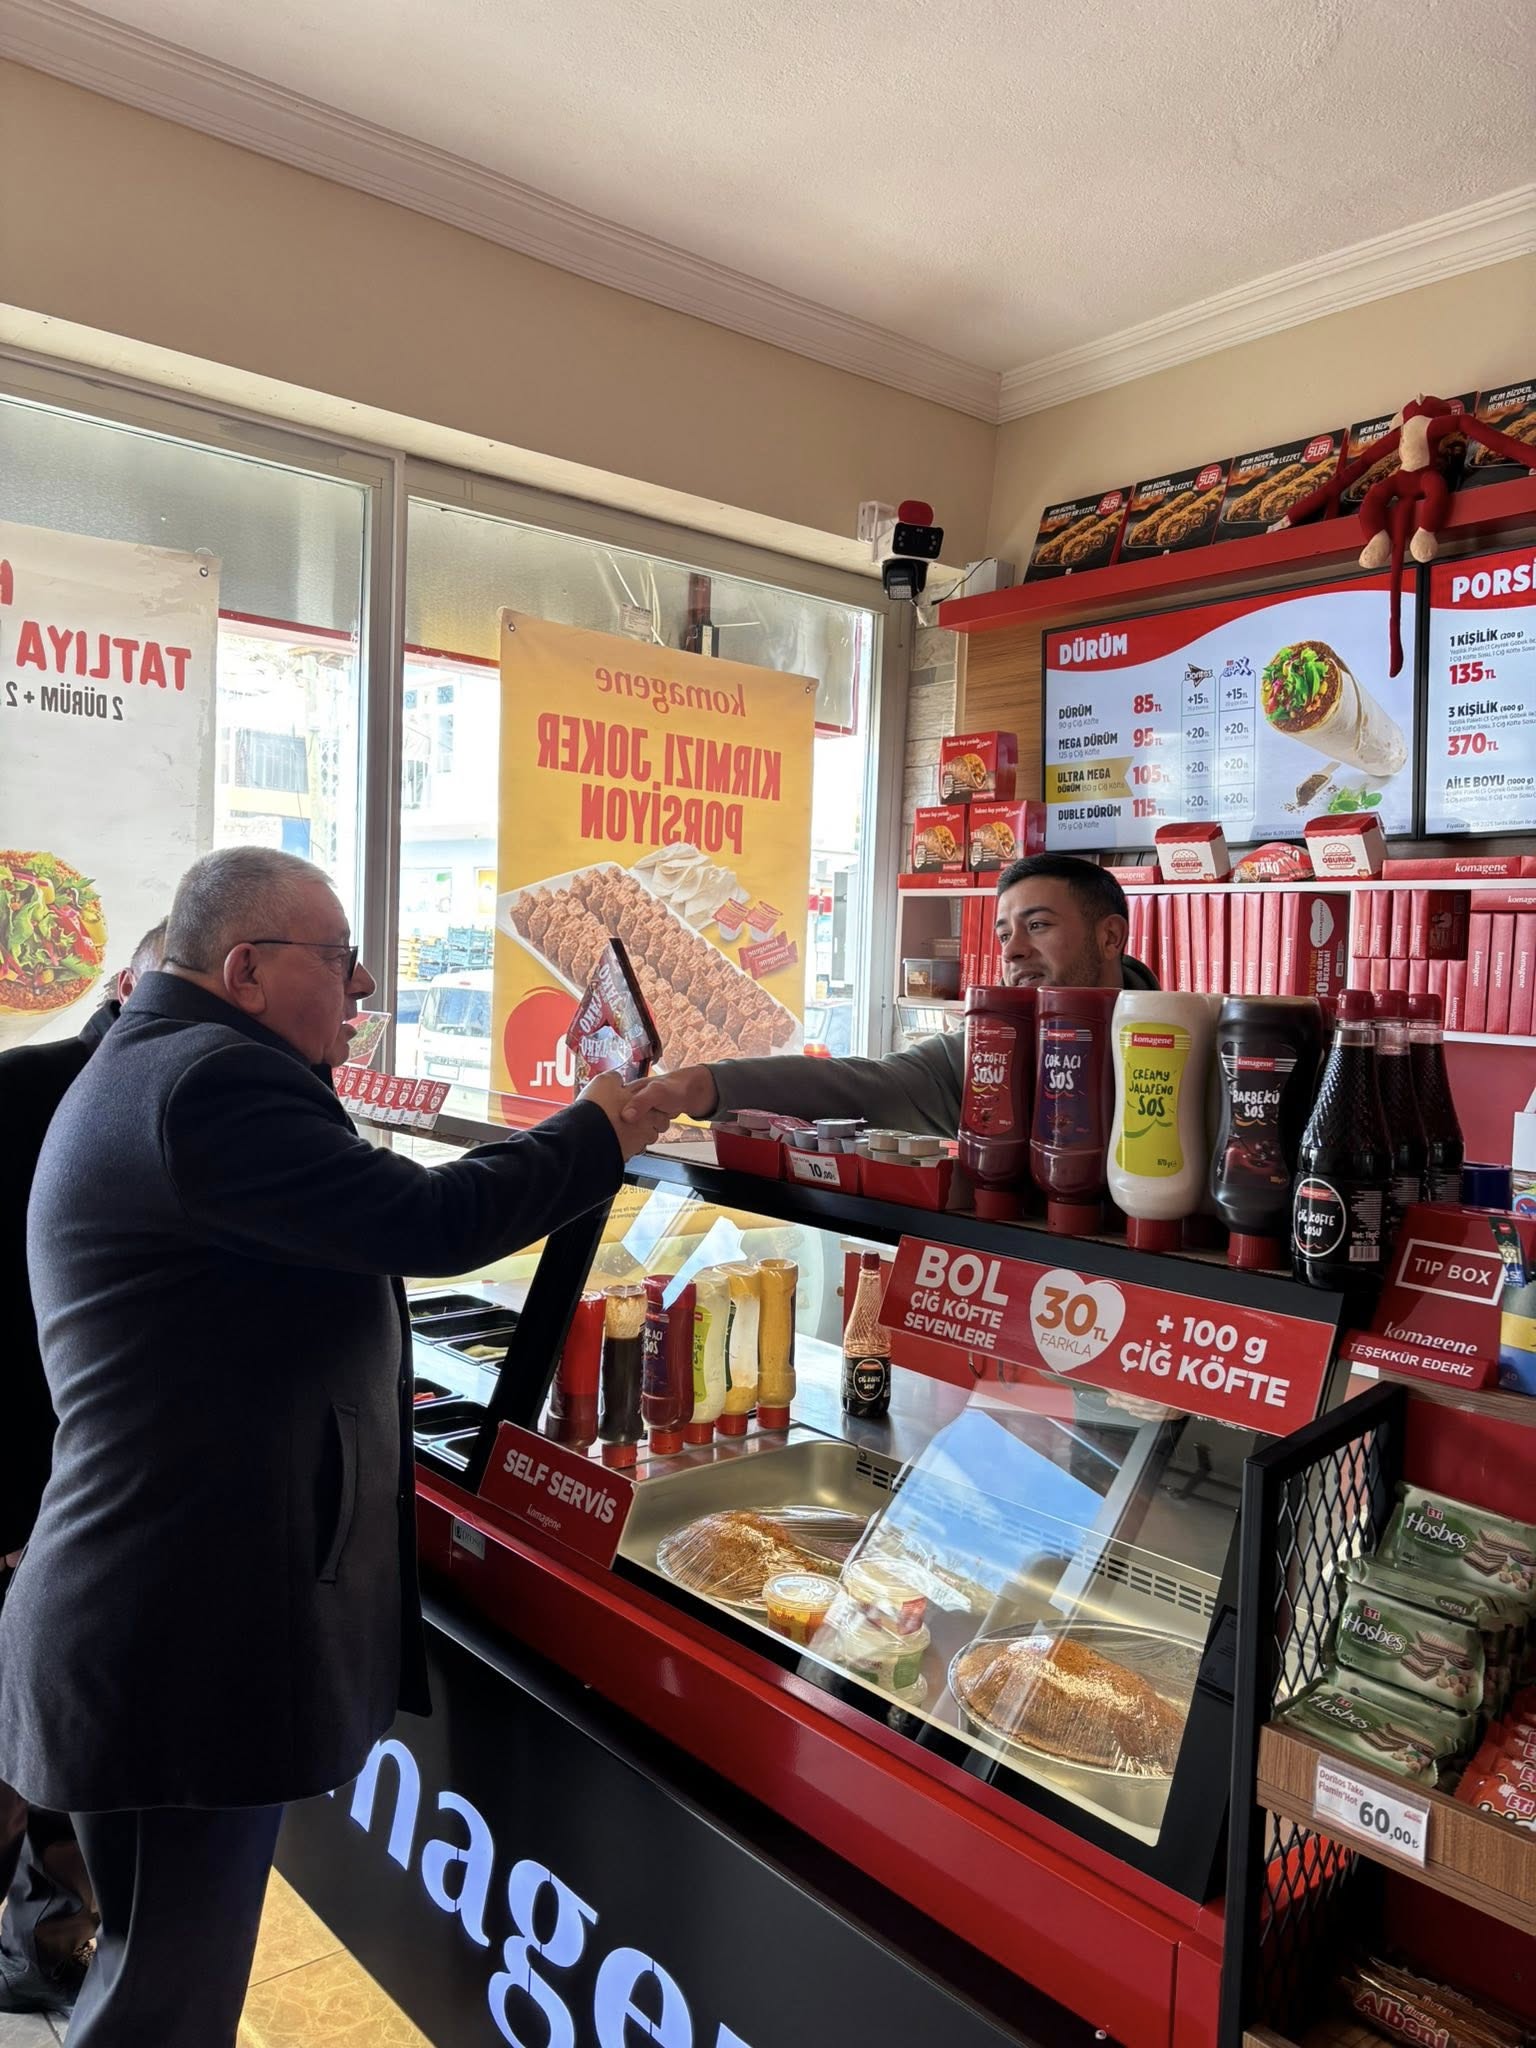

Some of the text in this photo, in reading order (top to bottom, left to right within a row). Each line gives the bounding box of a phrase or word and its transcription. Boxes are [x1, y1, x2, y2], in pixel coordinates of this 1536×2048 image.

[1450, 636, 1456, 648] 1
[1457, 628, 1498, 646] KİŞİLİK
[1060, 632, 1128, 666] DÜRÜM
[1059, 704, 1092, 720] DÜRÜM
[1448, 707, 1455, 719] 3
[1457, 700, 1498, 718] KİŞİLİK
[1058, 732, 1118, 751] MEGA DÜRÜM
[1057, 768, 1111, 784] ULTRA MEGA
[1446, 775, 1471, 789] AİLE
[1473, 774, 1505, 788] BOYU
[1057, 783, 1081, 794] DÜRÜM
[1058, 803, 1122, 821] DUBLE DÜRÜM
[1253, 860, 1280, 876] TAKO
[1454, 862, 1508, 875] komagene
[1472, 949, 1483, 988] komagene
[1494, 950, 1506, 989] komagene
[1518, 949, 1530, 989] komagene
[1133, 1034, 1173, 1046] komagene
[1062, 1055, 1081, 1069] ACI
[1238, 1058, 1274, 1069] komagene
[973, 1064, 1005, 1084] SOSU
[1049, 1070, 1075, 1090] SOS
[1132, 1068, 1170, 1081] CREAMY
[1137, 1095, 1166, 1118] SOS
[1232, 1088, 1281, 1105] BARBEKÜ
[1243, 1103, 1266, 1119] SOS
[1309, 1212, 1336, 1227] KÖFTE
[1303, 1225, 1323, 1237] SOSU
[914, 1245, 1009, 1306] BOL
[1415, 1258, 1492, 1286] TIP BOX
[910, 1289, 1004, 1330] ÇİĞ KÖFTE
[904, 1311, 998, 1350] SEVENLERE
[1156, 1314, 1268, 1365] + 100 g
[1383, 1321, 1478, 1357] komagene
[1040, 1332, 1093, 1357] FARKLA
[1350, 1343, 1474, 1378] TEŞEKKÜR EDERİZ
[1119, 1339, 1291, 1408] ÇİĞ KÖFTE
[503, 1449, 618, 1524] SELF SERVİS
[526, 1503, 562, 1532] komagene
[1319, 1769, 1365, 1797] Doritos Tako
[1354, 1990, 1450, 2048] Albeni
